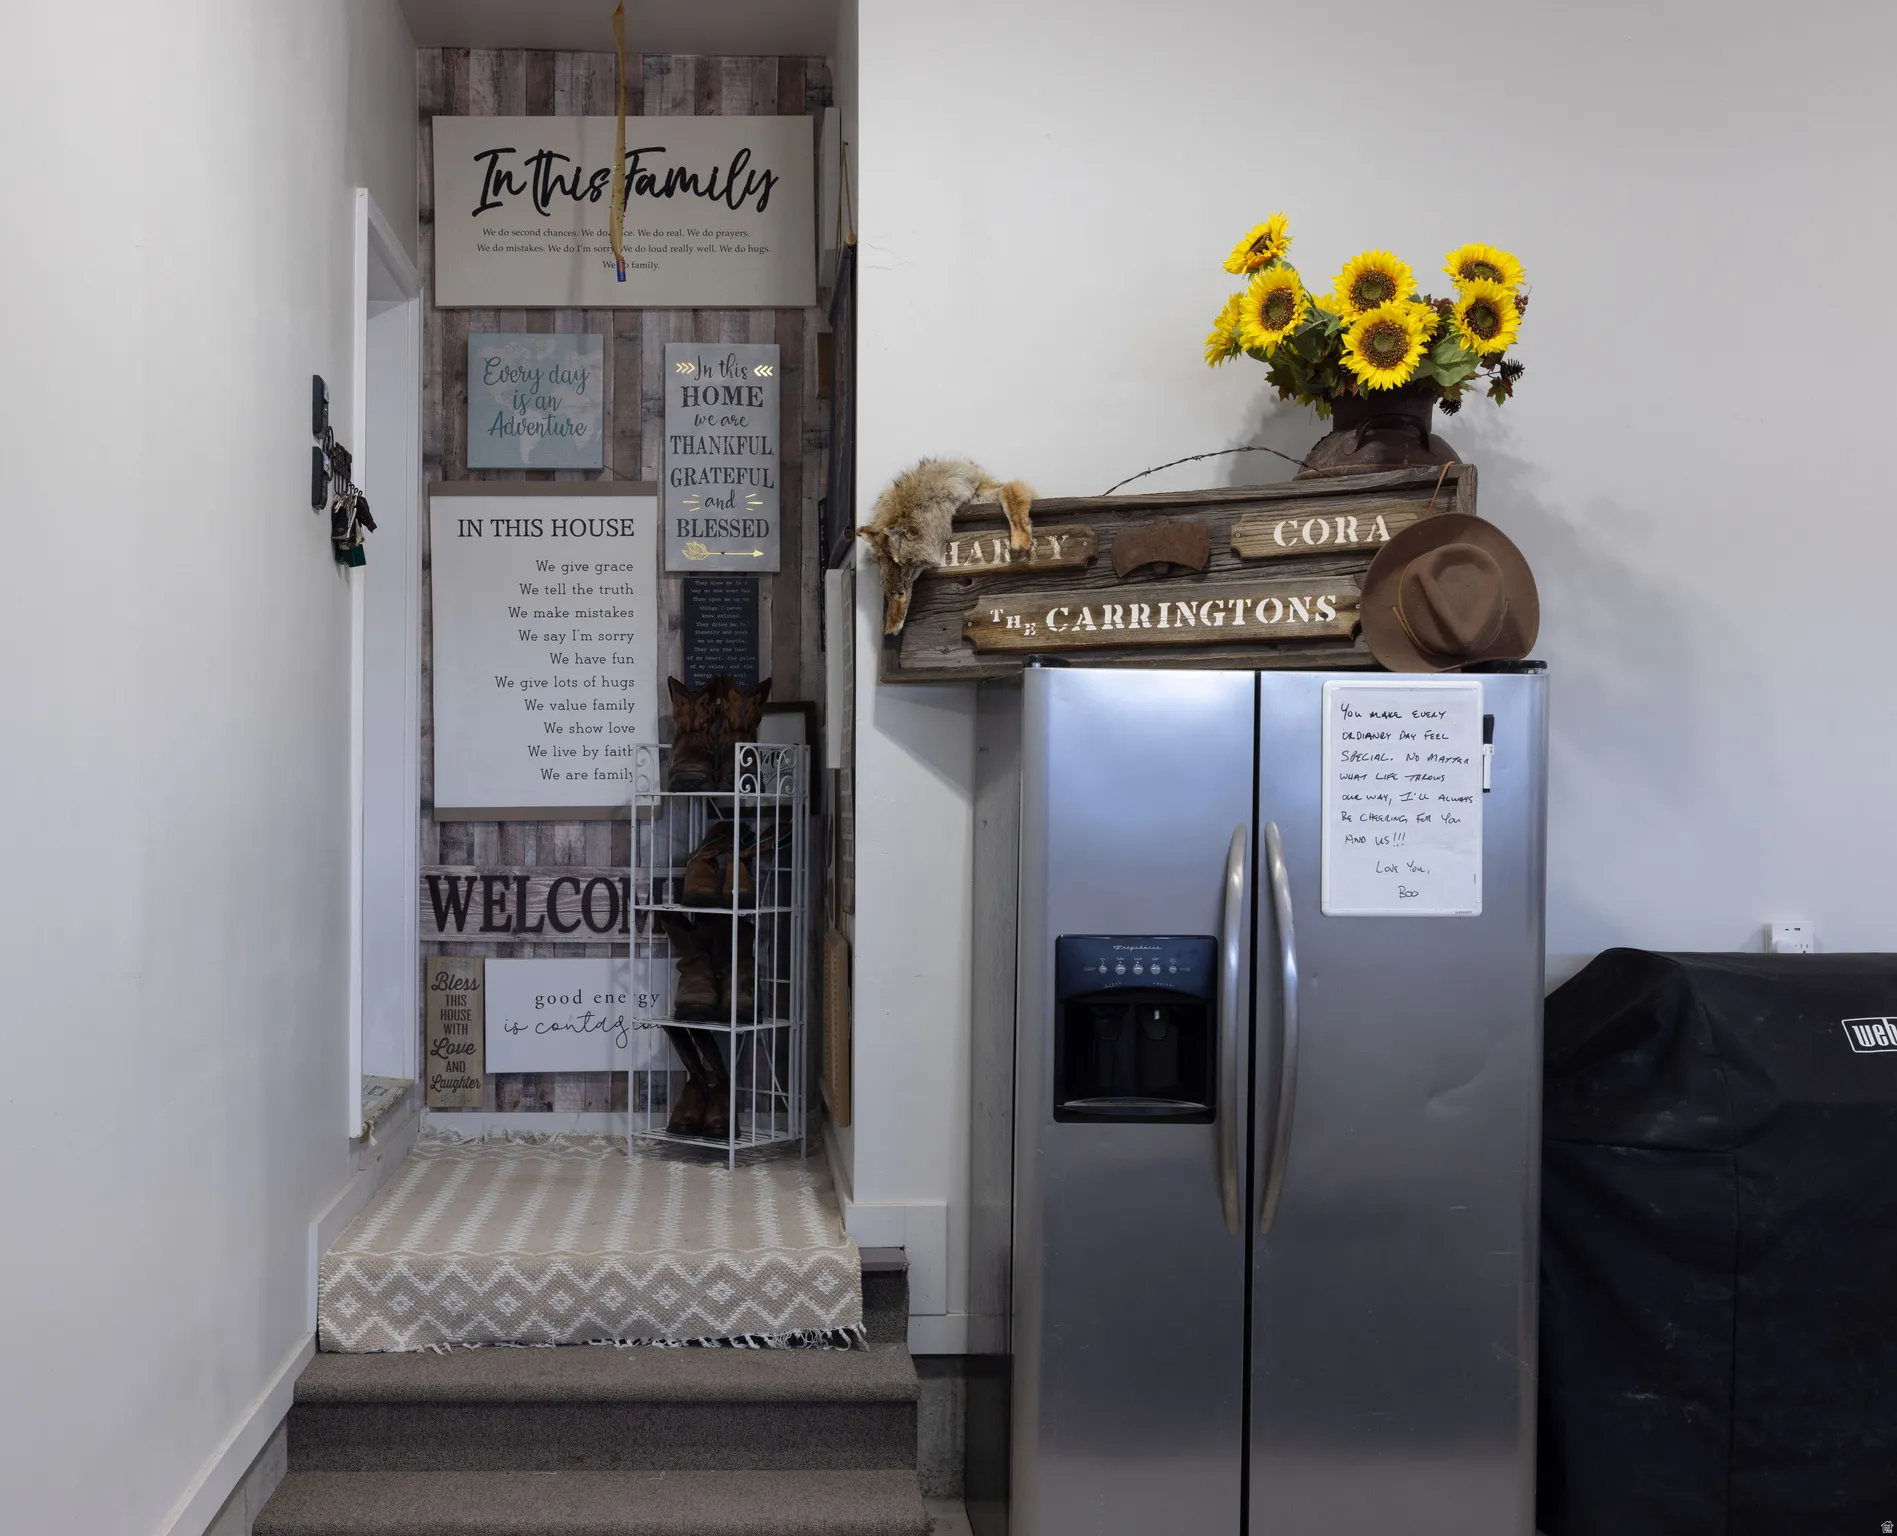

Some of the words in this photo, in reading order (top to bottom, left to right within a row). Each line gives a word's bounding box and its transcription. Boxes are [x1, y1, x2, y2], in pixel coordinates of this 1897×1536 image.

[472, 147, 527, 217] In
[524, 149, 611, 217] this
[624, 146, 779, 213] Family
[483, 229, 496, 237] We
[498, 229, 509, 237] do
[512, 229, 541, 237] second
[543, 229, 579, 237] chances.
[581, 229, 595, 237] We
[597, 229, 607, 237] do
[637, 229, 651, 237] We
[654, 229, 664, 237] do
[666, 229, 685, 237] real.
[687, 229, 700, 237] We
[702, 229, 713, 237] do
[715, 229, 749, 239] prayers.
[477, 244, 490, 252] We
[492, 244, 503, 252] do
[506, 244, 545, 252] mistakes.
[548, 244, 561, 252] We
[564, 244, 574, 252] do
[577, 244, 591, 252] I'm
[635, 244, 646, 252] do
[649, 244, 668, 252] loud
[670, 244, 693, 254] really
[694, 244, 717, 252] well.
[719, 244, 732, 252] We
[734, 244, 746, 252] do
[748, 244, 771, 254] hugs.
[602, 261, 616, 269] We
[631, 261, 660, 270] family.
[693, 354, 713, 381] In
[719, 352, 748, 380] this
[483, 356, 545, 395] Every
[548, 364, 591, 396] day
[513, 389, 532, 416] is
[535, 394, 562, 412] an
[680, 385, 764, 408] HOME
[487, 410, 588, 438] Adventure
[694, 414, 719, 428] we
[720, 414, 750, 428] are
[670, 467, 775, 489] GRATEFUL
[704, 488, 737, 510] and
[457, 518, 484, 538] IN
[490, 518, 544, 538] THIS
[551, 518, 635, 538] HOUSE
[676, 518, 770, 538] BLESSED
[1273, 514, 1391, 547] CORA
[535, 560, 556, 573] We
[561, 560, 589, 576] give
[594, 563, 634, 576] grace
[519, 583, 539, 596] We
[544, 583, 567, 596] tell
[571, 583, 594, 596] the
[599, 583, 634, 596] truth
[508, 606, 528, 619] We
[533, 606, 570, 619] make
[575, 606, 634, 619] mistakes
[990, 608, 1037, 636] THE
[1045, 595, 1337, 632] CARRINGTONS
[518, 629, 538, 642] We
[543, 631, 567, 644] say
[572, 629, 593, 642] I'm
[598, 631, 635, 644] sorry
[549, 652, 570, 665] We
[574, 652, 607, 665] have
[611, 652, 635, 665] fun
[495, 675, 515, 688] We
[520, 675, 549, 691] give
[553, 675, 578, 688] lots
[583, 675, 597, 688] of
[601, 675, 635, 691] hugs
[524, 699, 544, 712] We
[549, 699, 587, 712] value
[592, 699, 636, 714] family
[1411, 710, 1446, 719] EVERY
[543, 722, 564, 735] We
[568, 722, 603, 735] show
[608, 722, 636, 735] love
[1399, 730, 1417, 740] DAY
[1424, 730, 1449, 740] FEEL
[527, 745, 548, 757] We
[552, 745, 577, 757] live
[582, 745, 600, 760] by
[540, 768, 561, 781] We
[565, 770, 589, 781] are
[1375, 772, 1398, 780] LIFE
[1360, 812, 1408, 824] CHEERING
[425, 874, 685, 934] WELCOM
[430, 971, 480, 991] Bless
[445, 994, 467, 1007] THIS
[535, 989, 583, 1010] good
[593, 993, 660, 1009] enegy
[440, 1008, 472, 1022] HOUSE
[443, 1022, 468, 1036] WITH
[504, 1018, 529, 1035] is
[430, 1037, 477, 1060] Love
[445, 1060, 466, 1073] AND
[430, 1073, 481, 1093] Laughter
